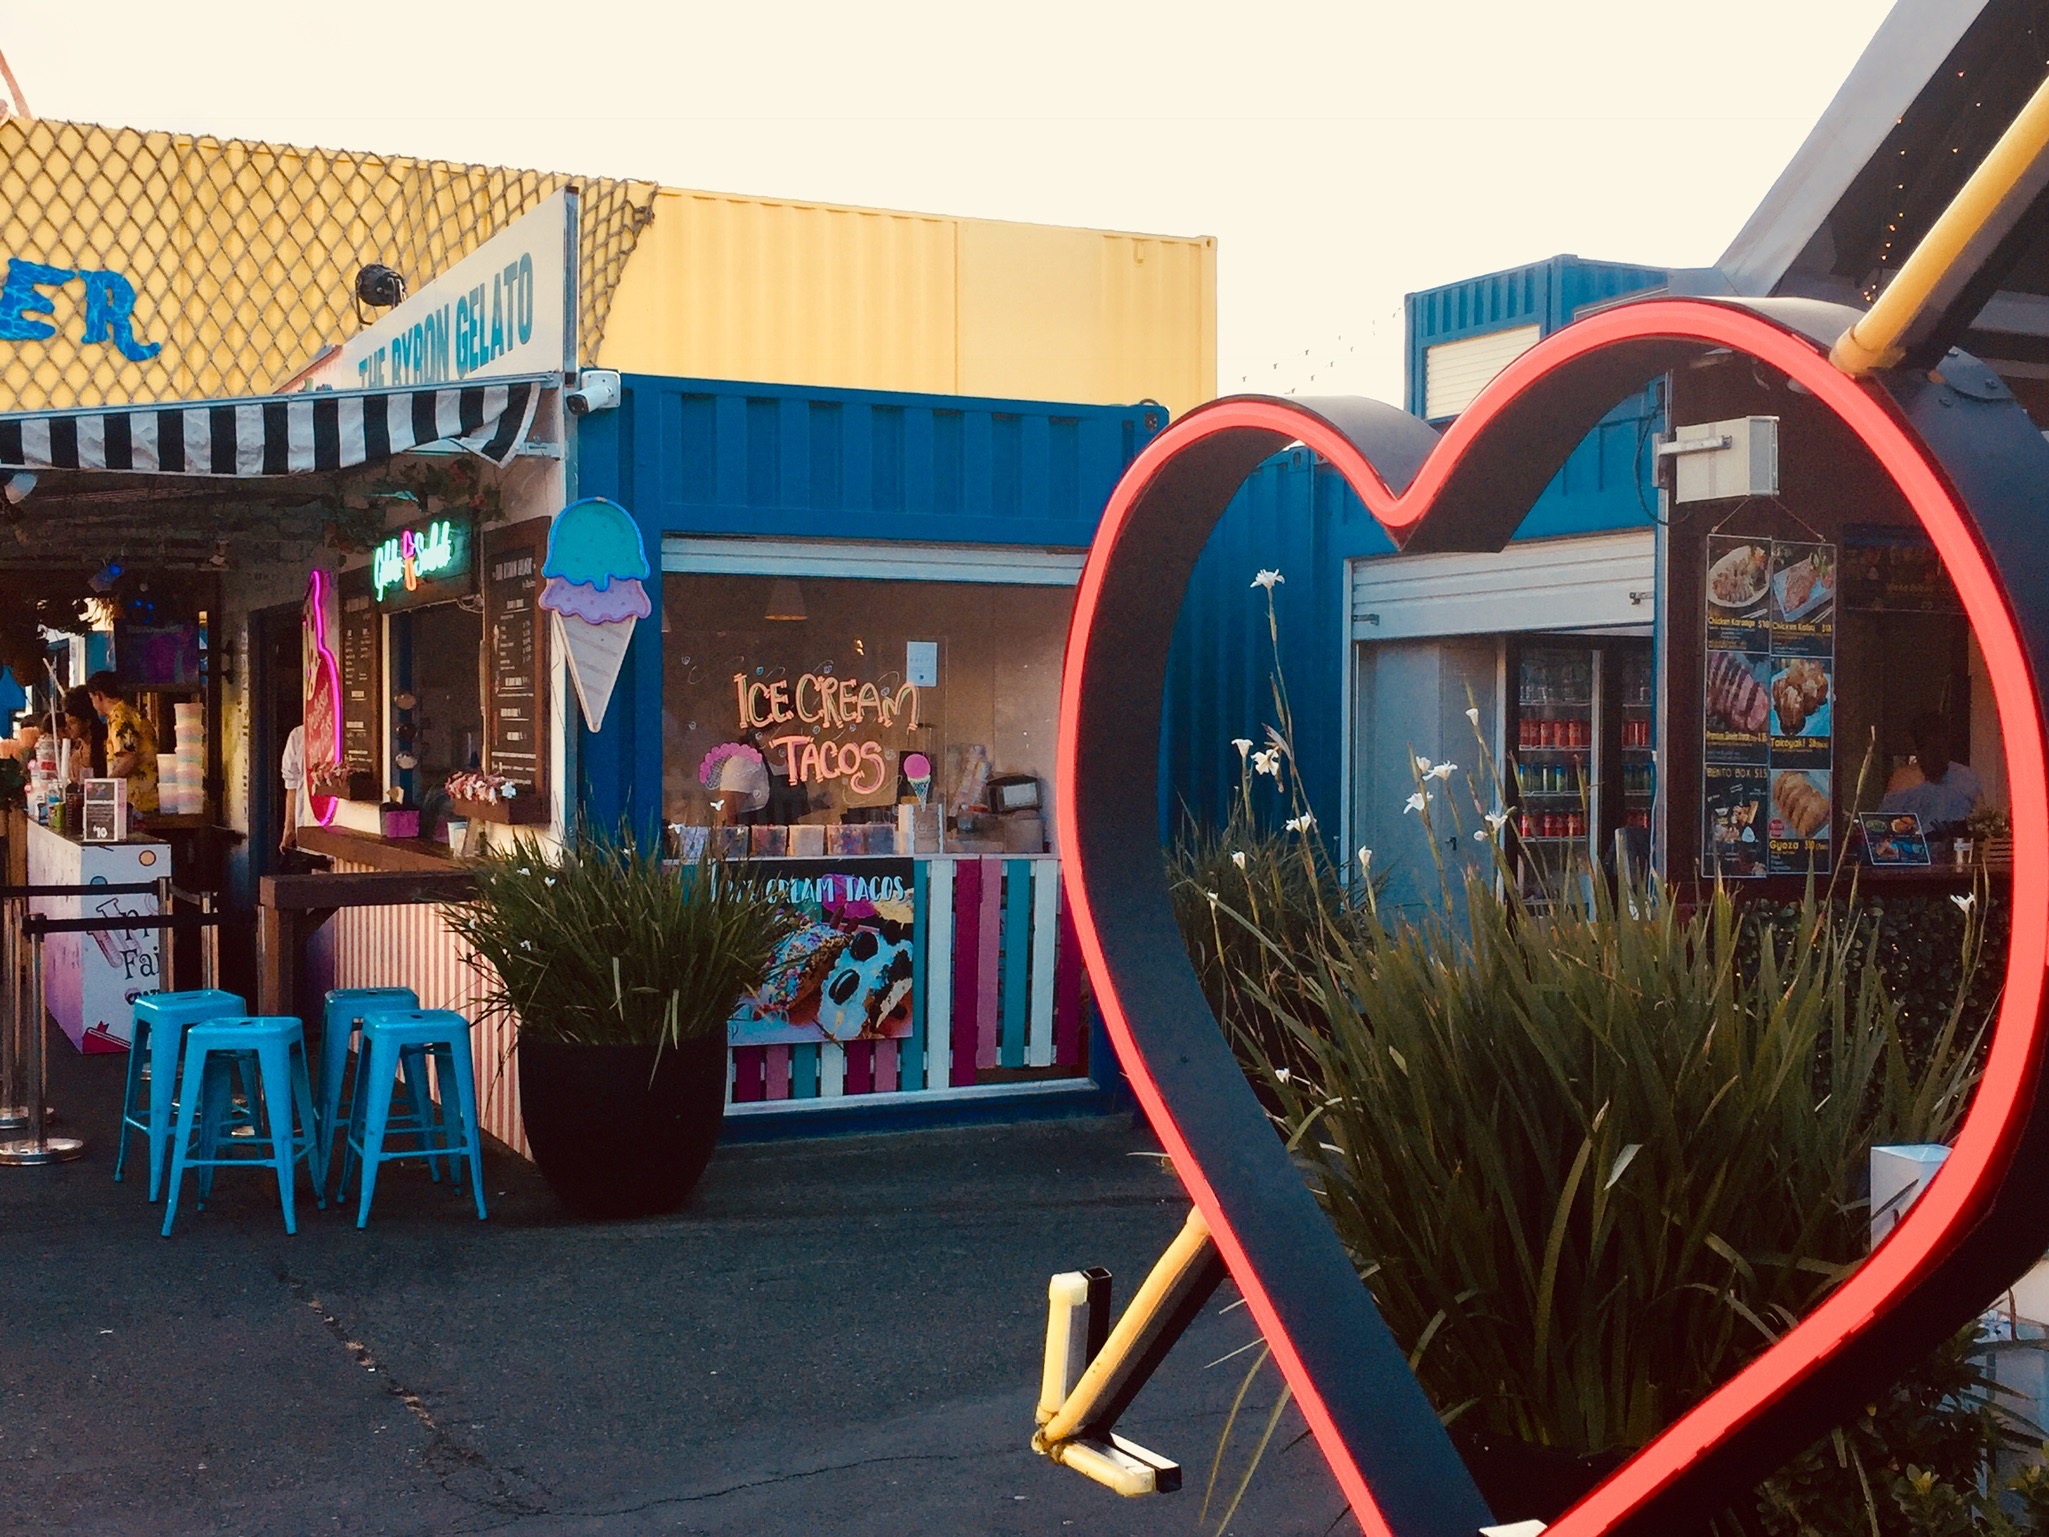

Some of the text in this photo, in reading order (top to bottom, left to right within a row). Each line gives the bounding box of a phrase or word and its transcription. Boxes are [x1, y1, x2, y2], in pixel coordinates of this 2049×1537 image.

[358, 252, 534, 388] THE BYRON GELATO
[734, 672, 919, 731] ICE CREAM
[769, 734, 886, 795] TACOS
[1706, 768, 1731, 778] BENTO
[1735, 768, 1751, 778] BOX
[1769, 840, 1799, 852] Gyoza
[766, 874, 834, 905] CREAM
[843, 875, 906, 903] TACOS
